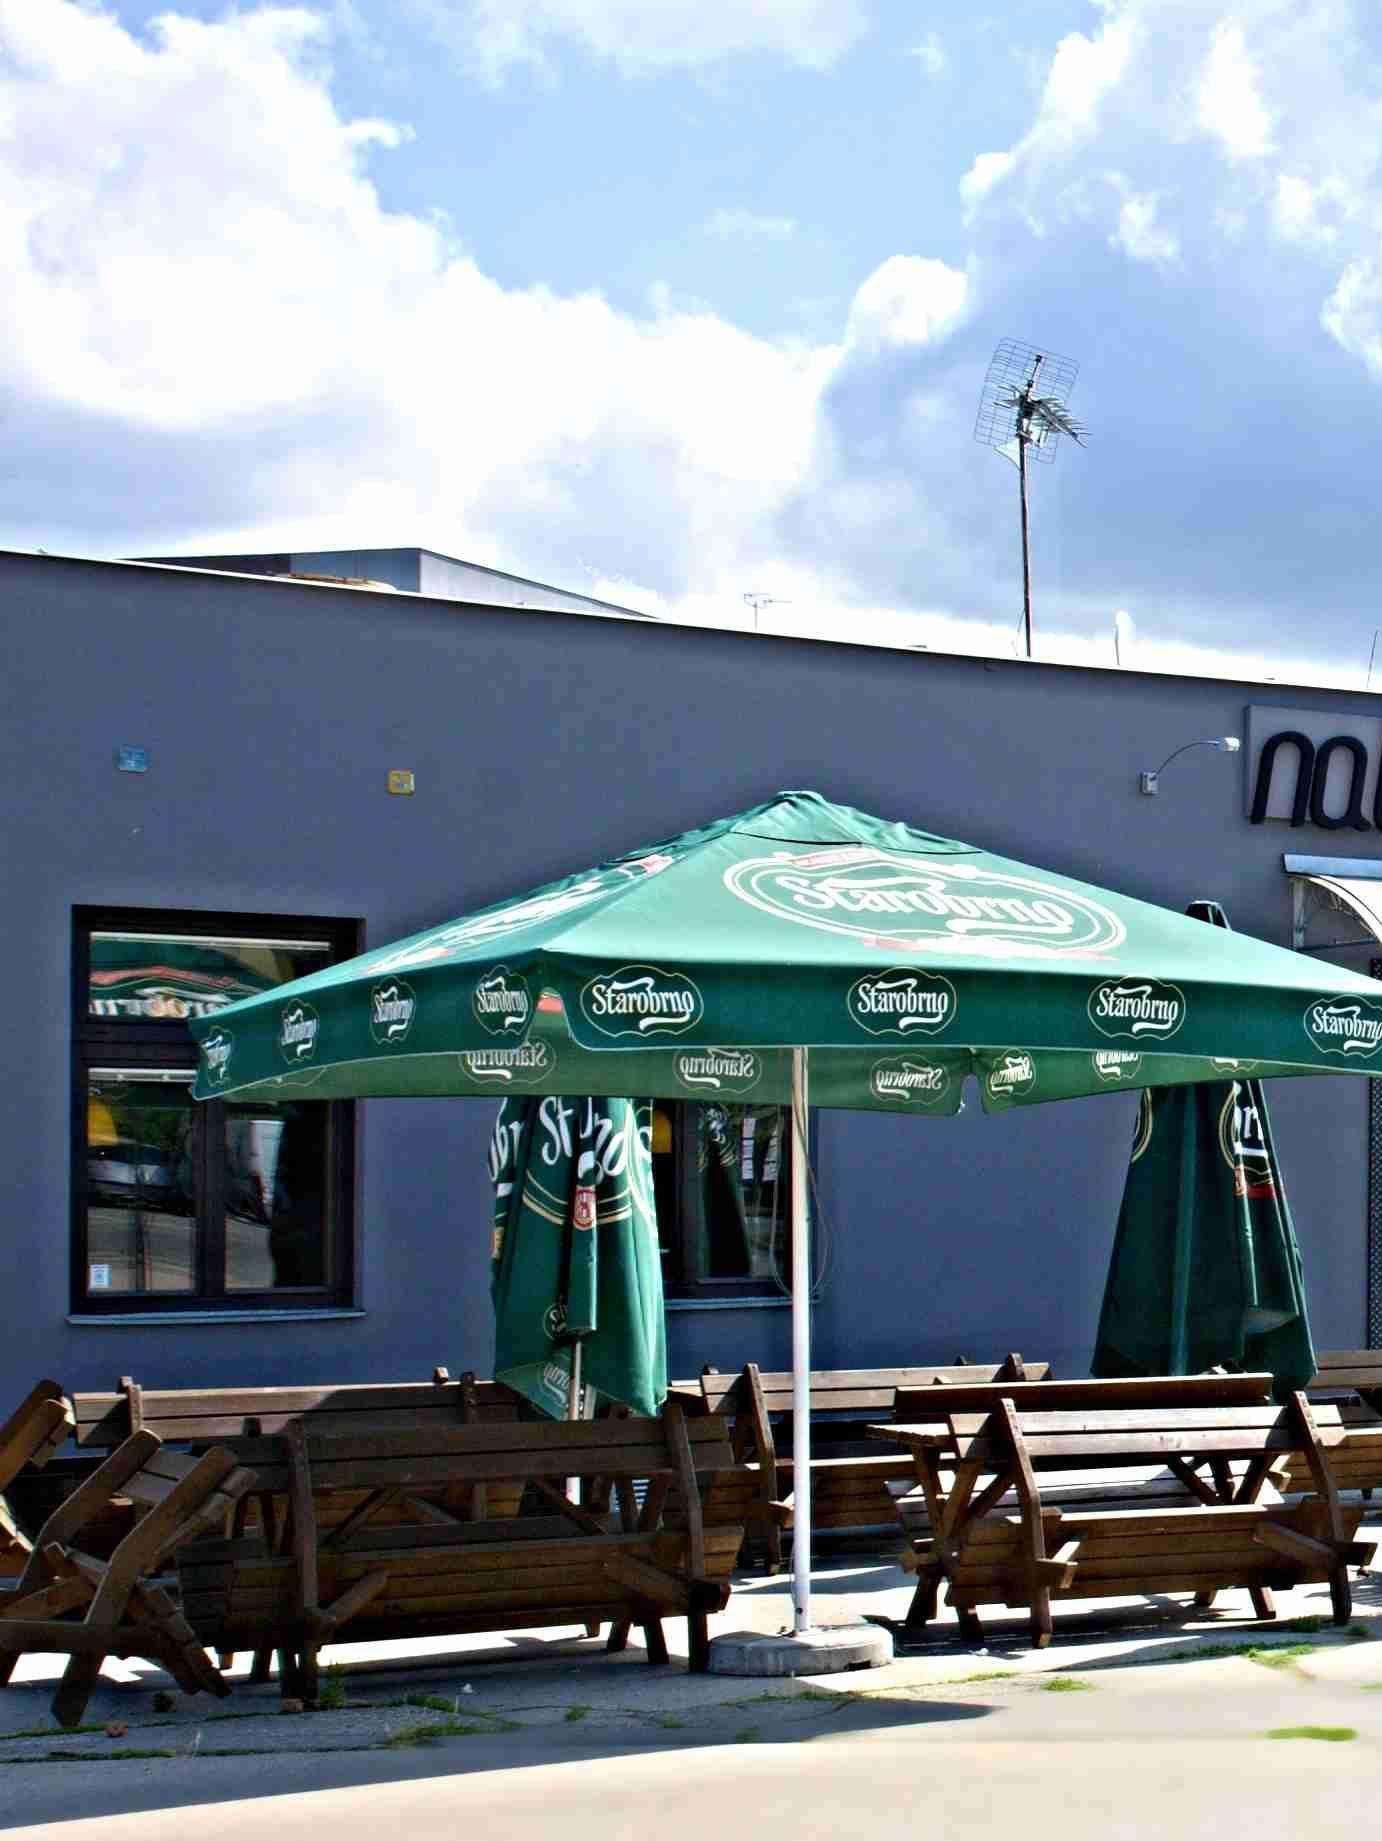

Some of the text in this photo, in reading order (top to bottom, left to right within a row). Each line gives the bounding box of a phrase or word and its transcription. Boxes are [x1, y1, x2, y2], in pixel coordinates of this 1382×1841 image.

[591, 975, 695, 1031] Starobrno
[856, 977, 949, 1030] Starobrno
[1095, 984, 1179, 1034] Starobrno
